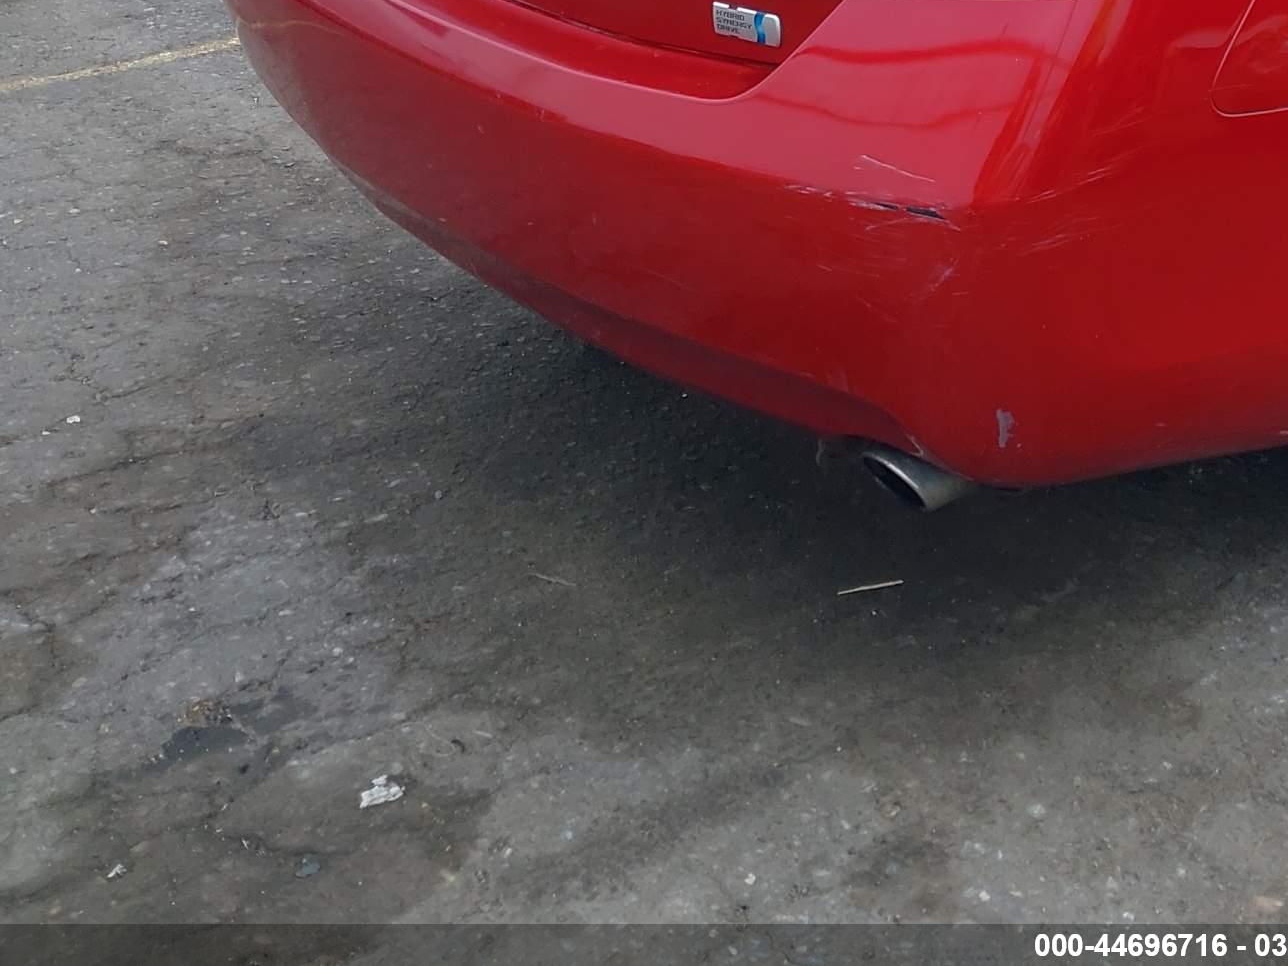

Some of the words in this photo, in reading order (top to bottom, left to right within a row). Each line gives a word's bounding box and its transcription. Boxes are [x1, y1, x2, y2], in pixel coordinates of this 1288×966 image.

[716, 9, 745, 22] HYBRID
[716, 16, 753, 30] SYNERGY
[716, 23, 739, 34] DRIVE
